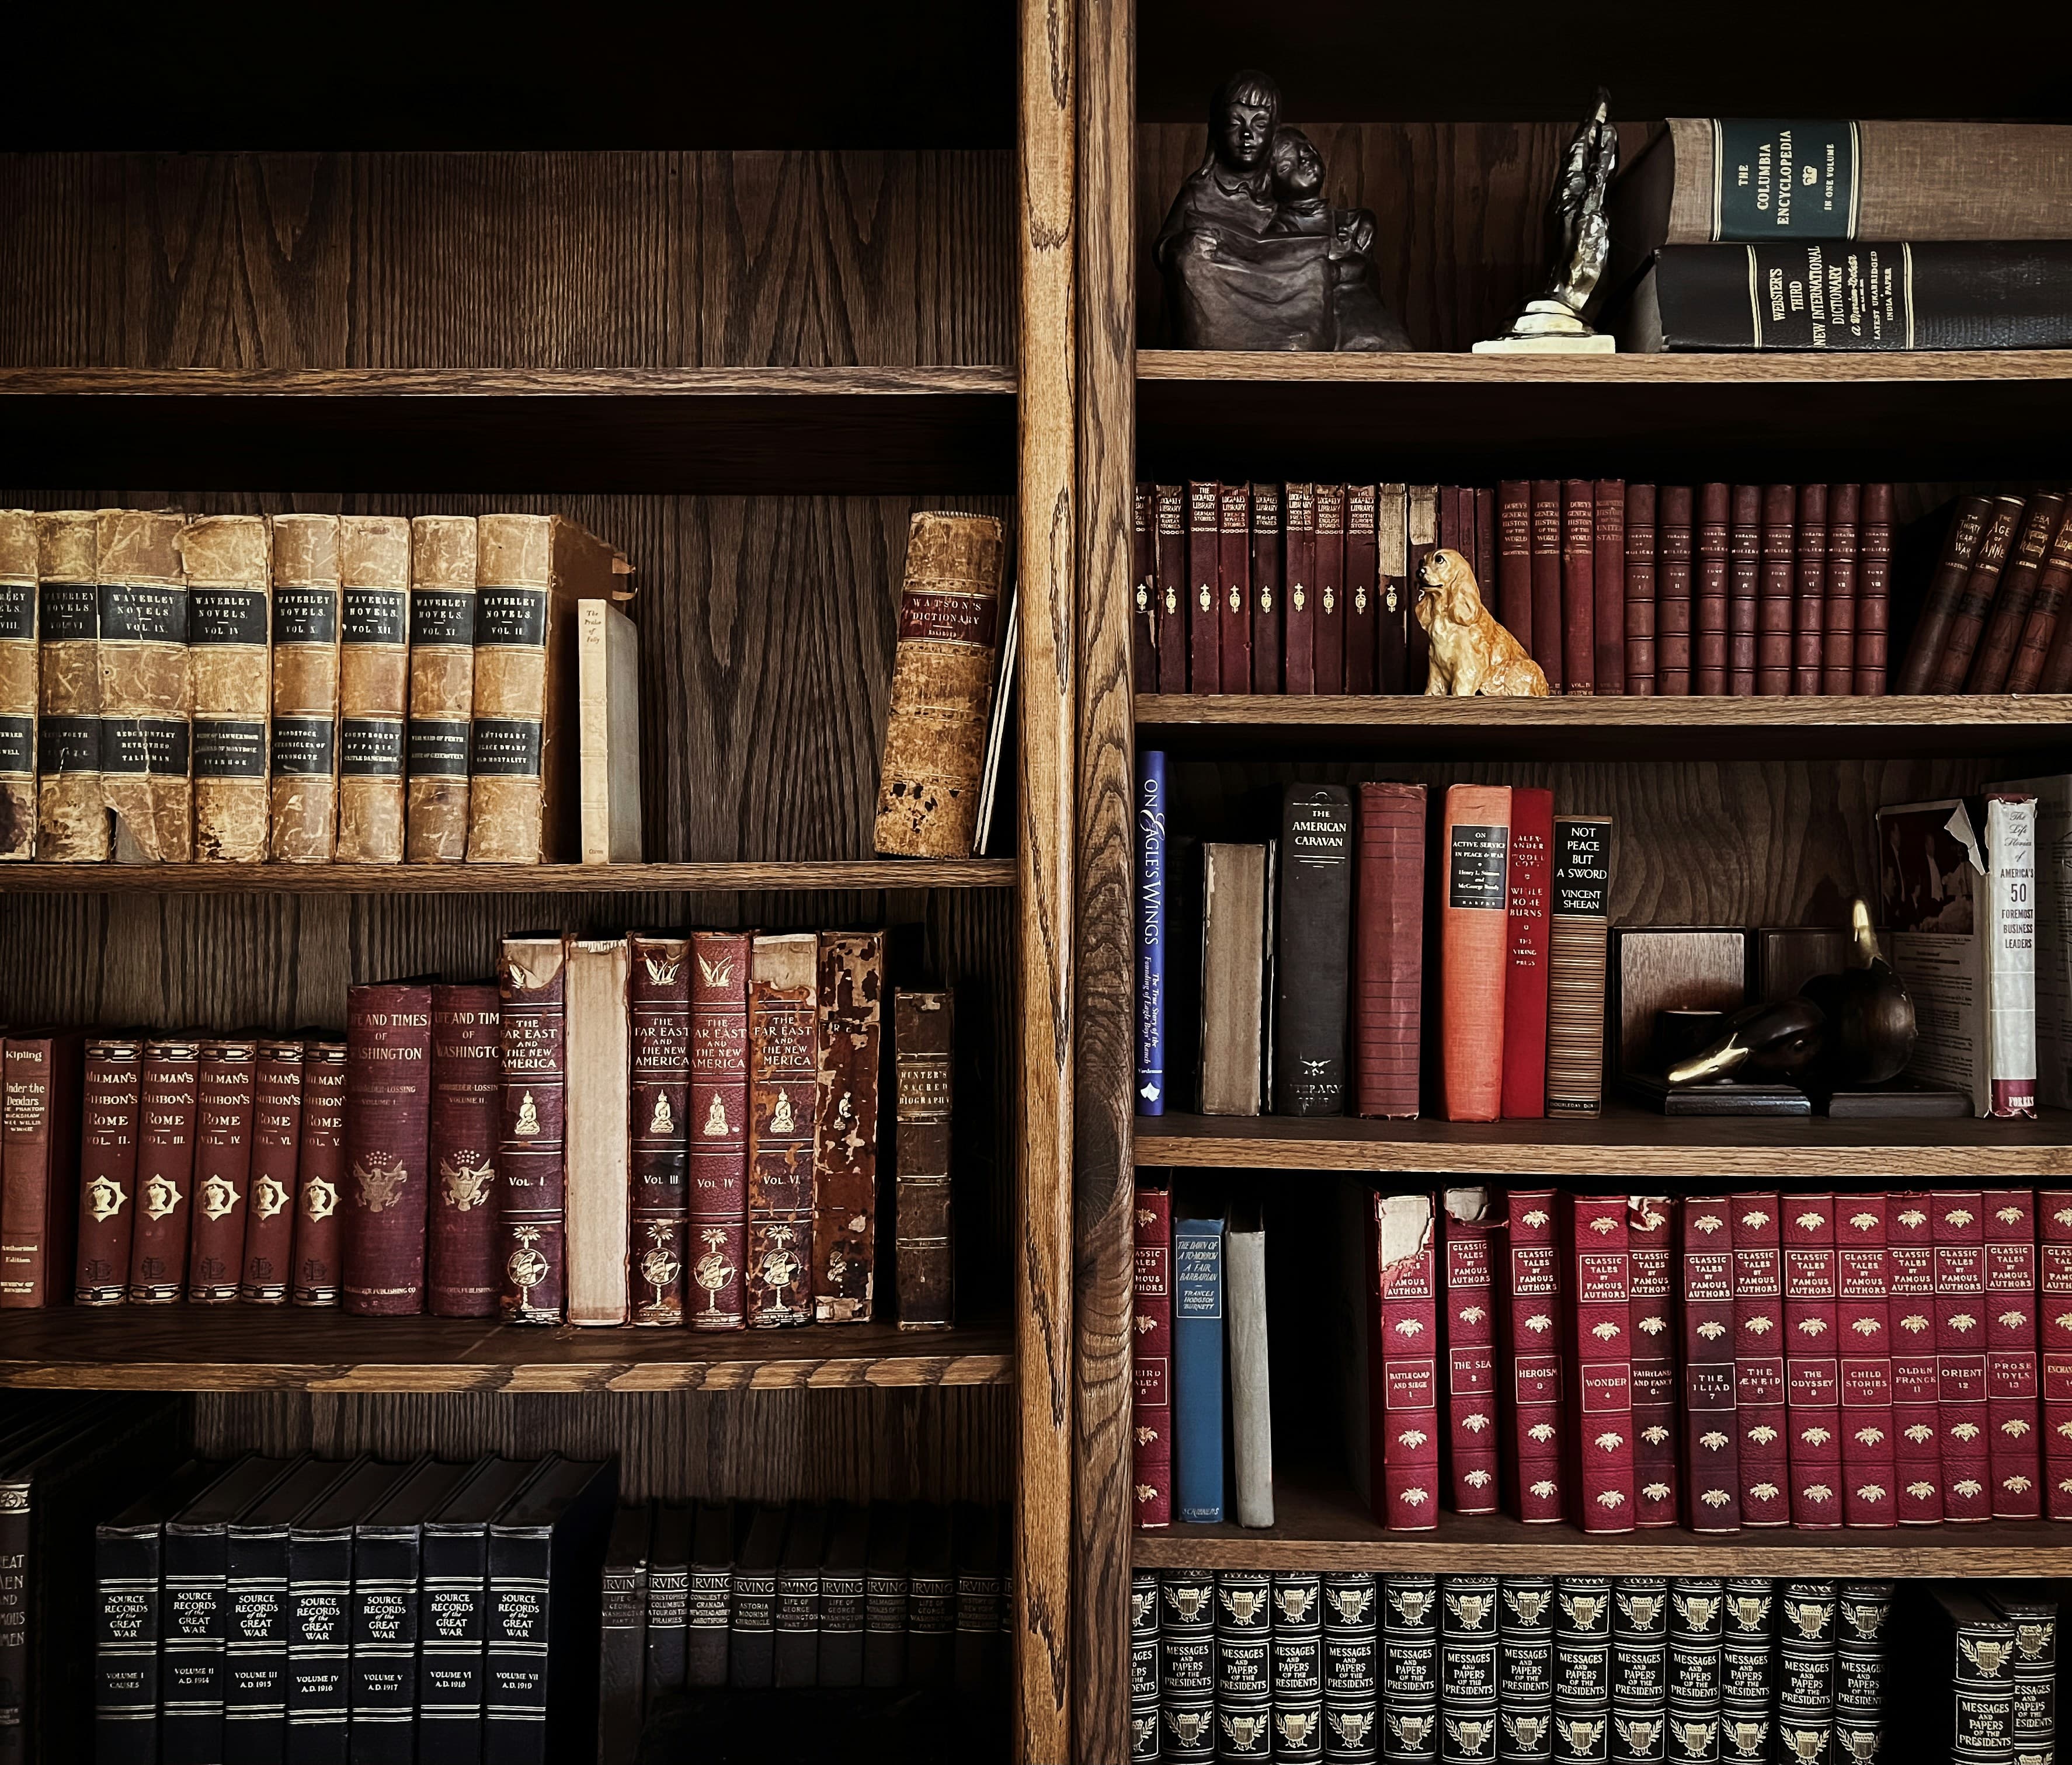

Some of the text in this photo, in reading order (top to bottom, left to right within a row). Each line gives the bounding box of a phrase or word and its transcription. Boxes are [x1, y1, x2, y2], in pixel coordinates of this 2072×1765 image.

[1825, 144, 1834, 177] VOLUME
[1739, 165, 1748, 186] THE
[1757, 143, 1771, 210] COLUMBIA
[1777, 130, 1791, 225] ENCYCLOPEDIA
[1824, 201, 1832, 211] IN
[1769, 268, 1786, 321] WEBSTER'S
[1789, 281, 1804, 311] THIRD
[1808, 246, 1826, 346] NEW INTERNATIONAL
[1829, 265, 1844, 325] DICTIONARY
[1987, 521, 2011, 537] AGE
[1979, 539, 2005, 559] ANNE
[347, 596, 402, 605] WAVERLEY
[484, 597, 536, 607] WAVERLEY
[913, 598, 981, 611] WATSON'S
[913, 613, 979, 625] DICTIONARY
[1144, 779, 1158, 807] ON
[1292, 821, 1347, 833] AMERICAN
[1571, 827, 1597, 838] NOT
[1294, 836, 1344, 847] CARAVAN
[1567, 841, 1600, 852] PEACE
[1572, 855, 1594, 865] BUT
[1556, 869, 1607, 880] A SWORD
[2000, 868, 2034, 879] AMERICA'S
[1561, 889, 1602, 900] VINCENT
[2011, 883, 2026, 903] 50
[1563, 900, 1600, 909] SHEEAN
[1142, 880, 1162, 945] WINGS
[2001, 909, 2033, 919] FOREMOST
[2003, 924, 2033, 934] BUSINESS
[2005, 939, 2032, 949] LEADERS
[1142, 956, 1152, 990] Founding
[1142, 1001, 1151, 1021] Eagle
[1150, 1007, 1160, 1026] Story
[366, 1014, 427, 1026] AND TIMES
[652, 1018, 673, 1026] THE
[376, 1032, 388, 1040] OF
[660, 1026, 689, 1037] EAST
[663, 1046, 686, 1054] NEW
[6, 1050, 43, 1063] Kipling
[635, 1056, 690, 1066] AMERICA
[86, 1072, 137, 1083] MILMAN'S
[29, 1082, 46, 1094] the
[6, 1095, 39, 1106] Deodars
[88, 1111, 128, 1126] ROME
[669, 1175, 679, 1184] III
[1208, 1241, 1218, 1249] OF
[1183, 1263, 1212, 1272] A FAIR
[1179, 1273, 1218, 1281] BARBARIAN
[1941, 1369, 1983, 1377] ORIENT
[1586, 1377, 1627, 1387] WONDER
[733, 1581, 774, 1593] IRVING
[300, 1597, 337, 1606] SOURCE
[297, 1607, 340, 1617] RECORDS
[301, 1623, 335, 1631] GREAT
[1559, 1652, 1603, 1663] MESSAGES
[1566, 1669, 1597, 1680] PAPERS
[1557, 1683, 1605, 1696] PRESIDENTS
